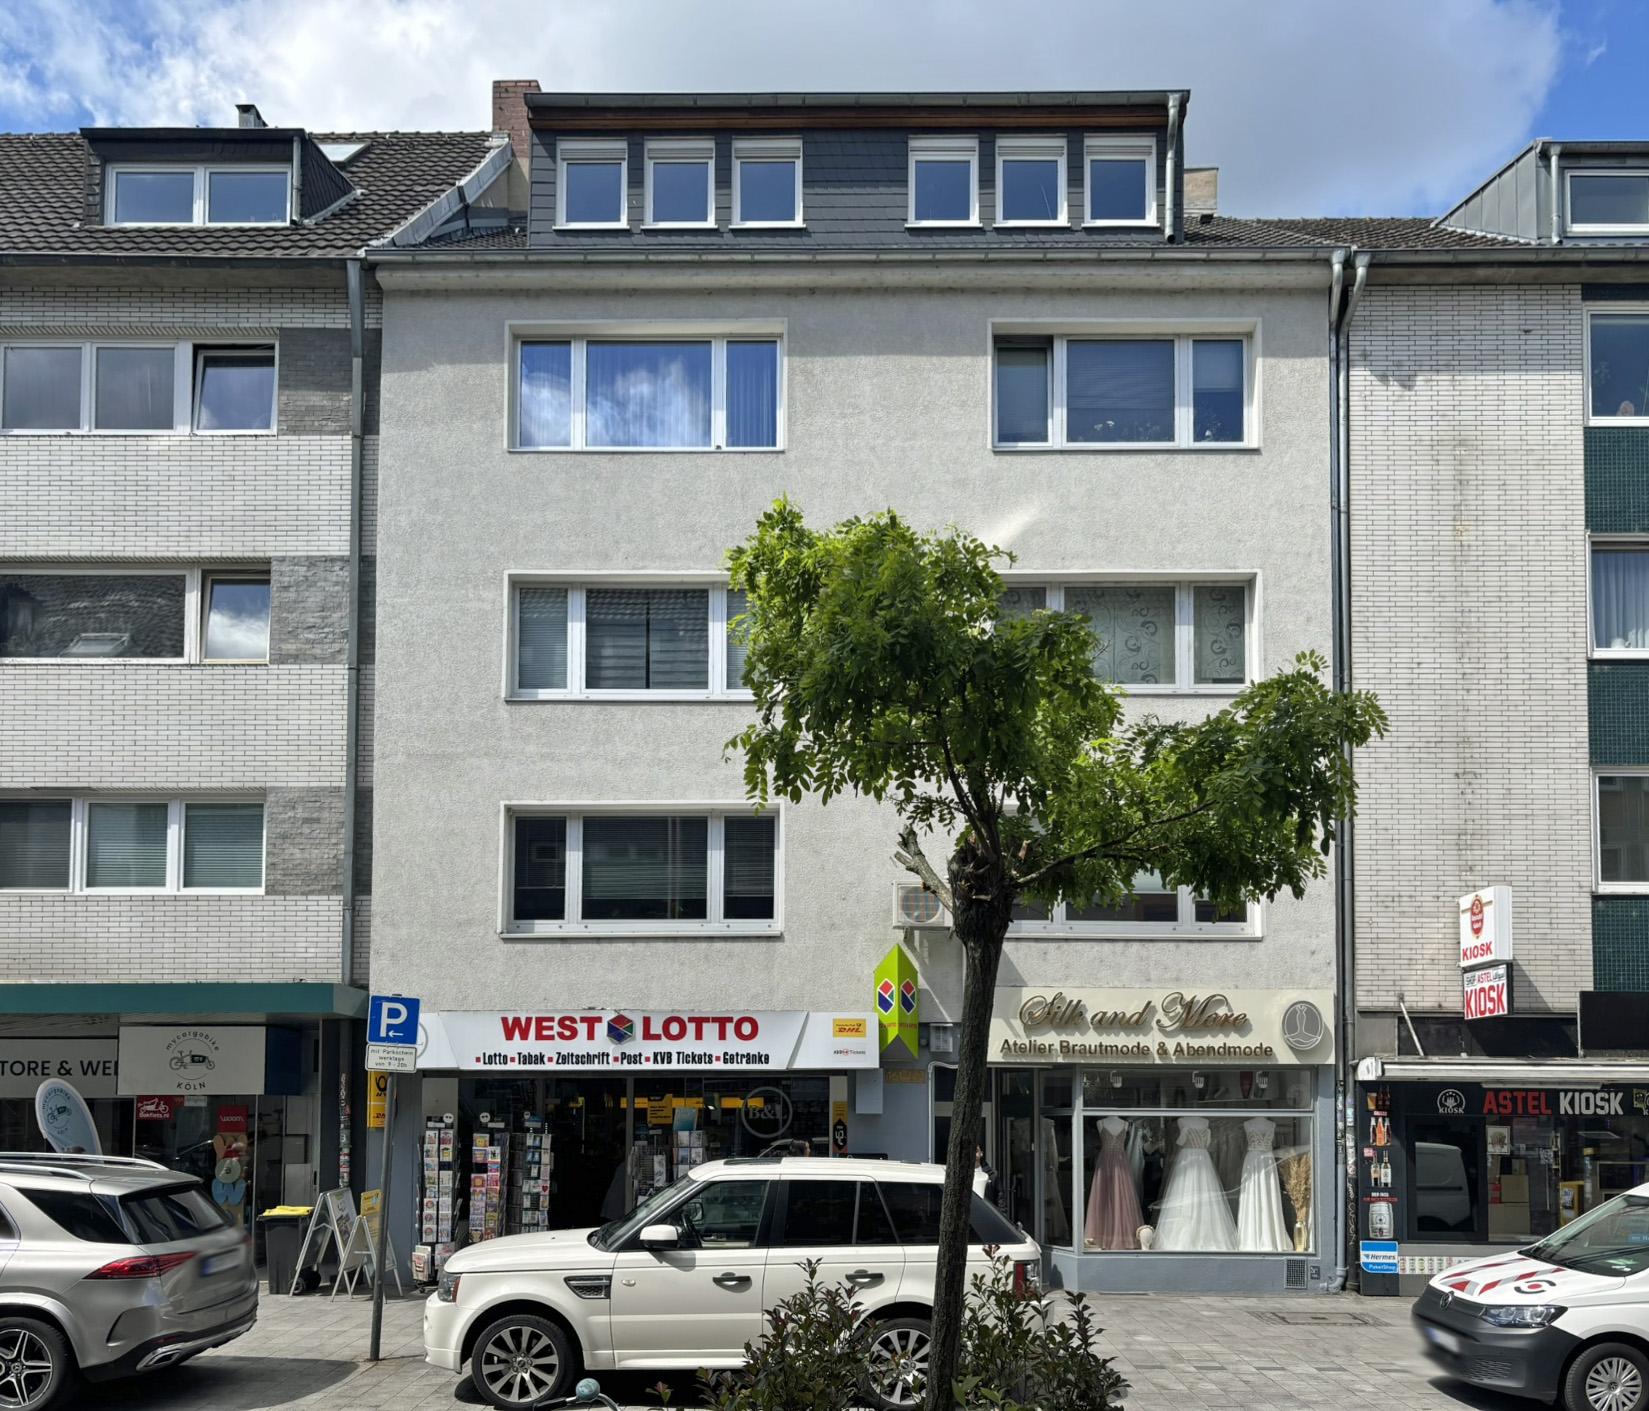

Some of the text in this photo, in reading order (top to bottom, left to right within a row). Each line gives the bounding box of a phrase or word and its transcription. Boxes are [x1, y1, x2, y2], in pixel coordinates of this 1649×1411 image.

[1462, 941, 1493, 961] KIOSK
[1477, 971, 1492, 983] ASTEL
[1465, 983, 1506, 1018] KIOSK
[380, 1002, 408, 1037] P
[1019, 992, 1248, 1033] Silk and More
[501, 1016, 759, 1041] WEST LOTTO
[166, 1031, 219, 1051] mycargobike
[1000, 1039, 1273, 1057] Atelier Brautmode & Abendmode
[0, 1060, 51, 1076] TORE
[57, 1060, 72, 1076] &
[483, 1051, 770, 1065] Lotto Tabak Zeitschrift Post KVB Tickets Getränke
[176, 1081, 206, 1090] KÖLN
[1439, 1106, 1465, 1114] KIOSK
[1483, 1091, 1624, 1115] ASTEL KIOSK
